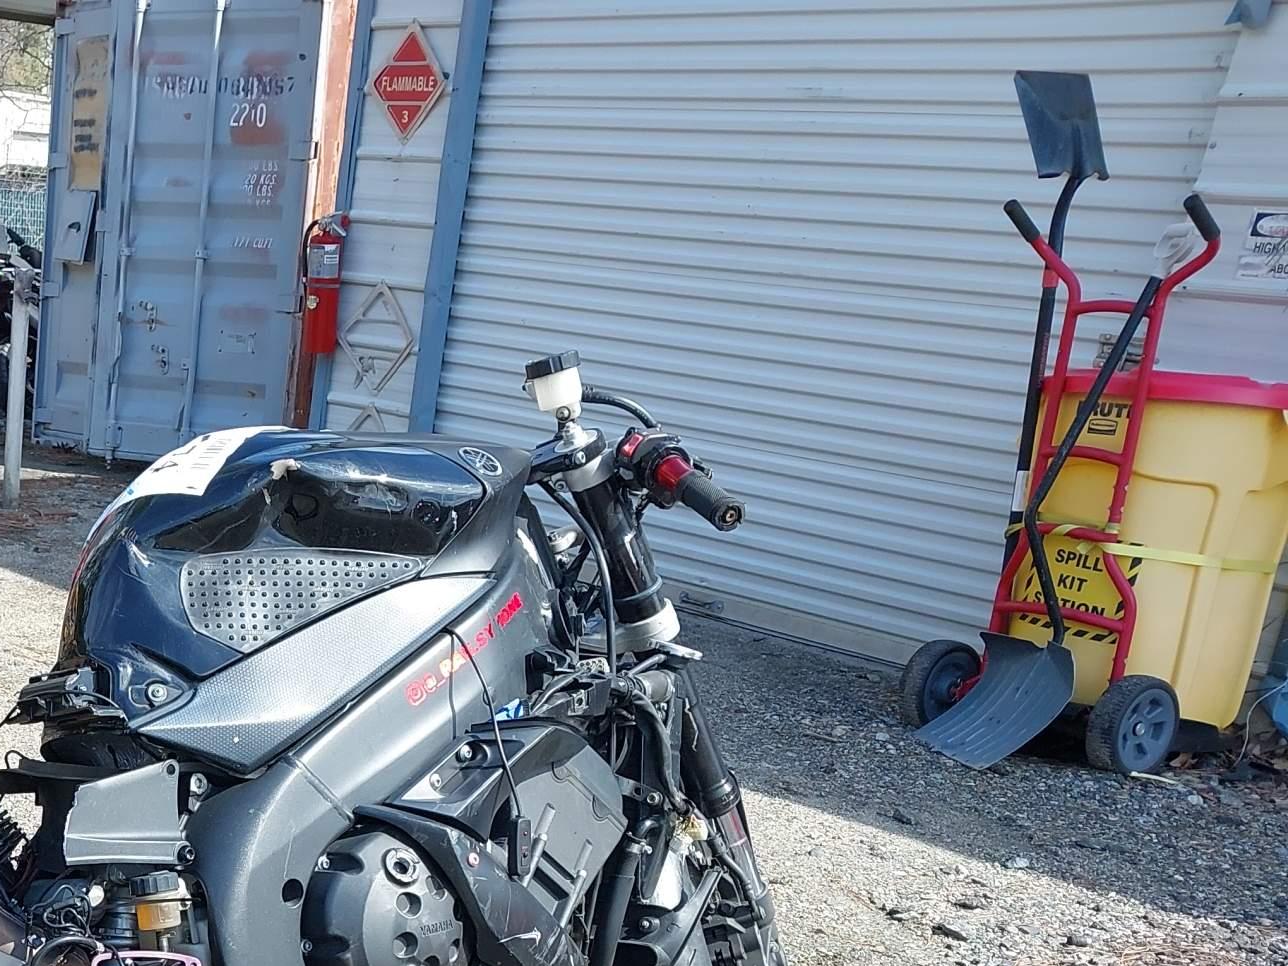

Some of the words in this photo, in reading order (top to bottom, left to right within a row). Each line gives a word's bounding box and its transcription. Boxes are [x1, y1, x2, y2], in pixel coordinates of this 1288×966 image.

[381, 76, 435, 92] FLAMMABLE
[401, 110, 409, 123] 3
[1055, 549, 1104, 573] SPILL
[1057, 573, 1088, 593] KIT
